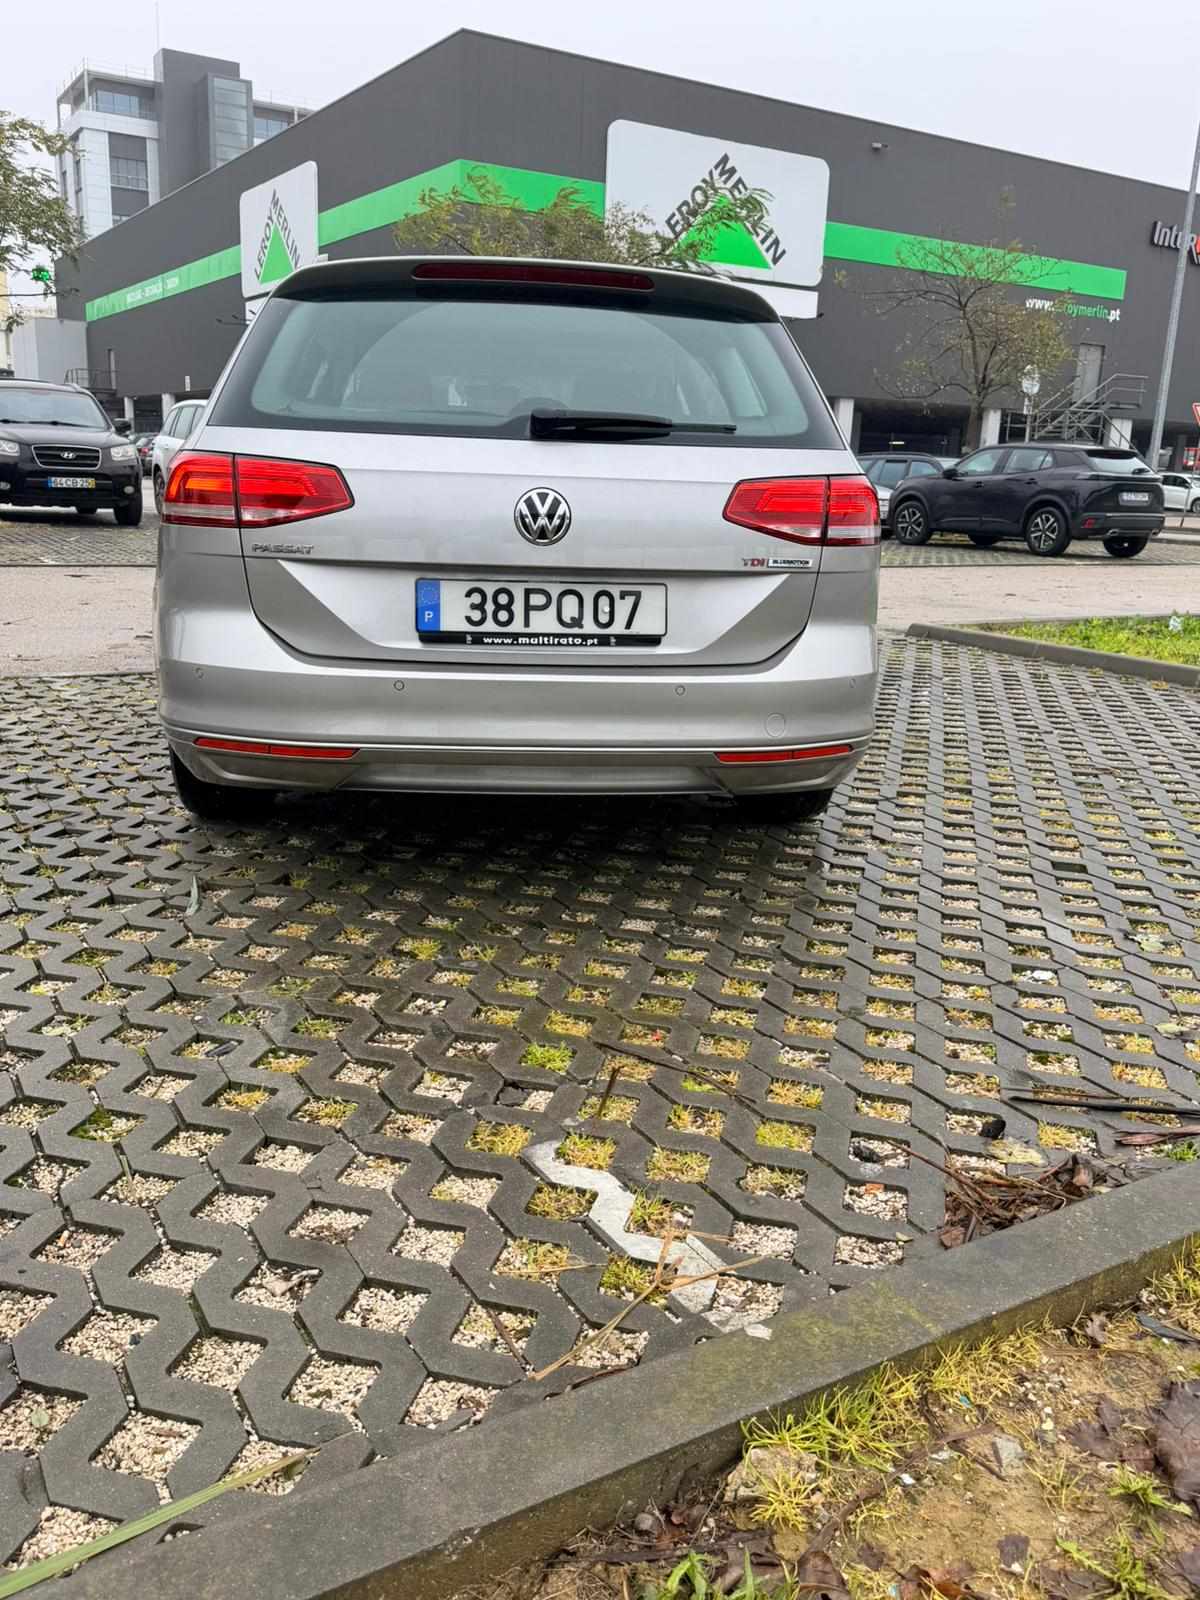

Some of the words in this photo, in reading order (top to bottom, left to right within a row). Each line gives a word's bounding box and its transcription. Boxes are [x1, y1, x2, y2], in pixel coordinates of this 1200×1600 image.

[254, 207, 276, 281] LEROY
[270, 188, 301, 270] MERLIN
[251, 543, 315, 555] PASSAT
[741, 558, 767, 567] TDI
[424, 611, 434, 623] P
[482, 634, 599, 647] www.multirato.pt
